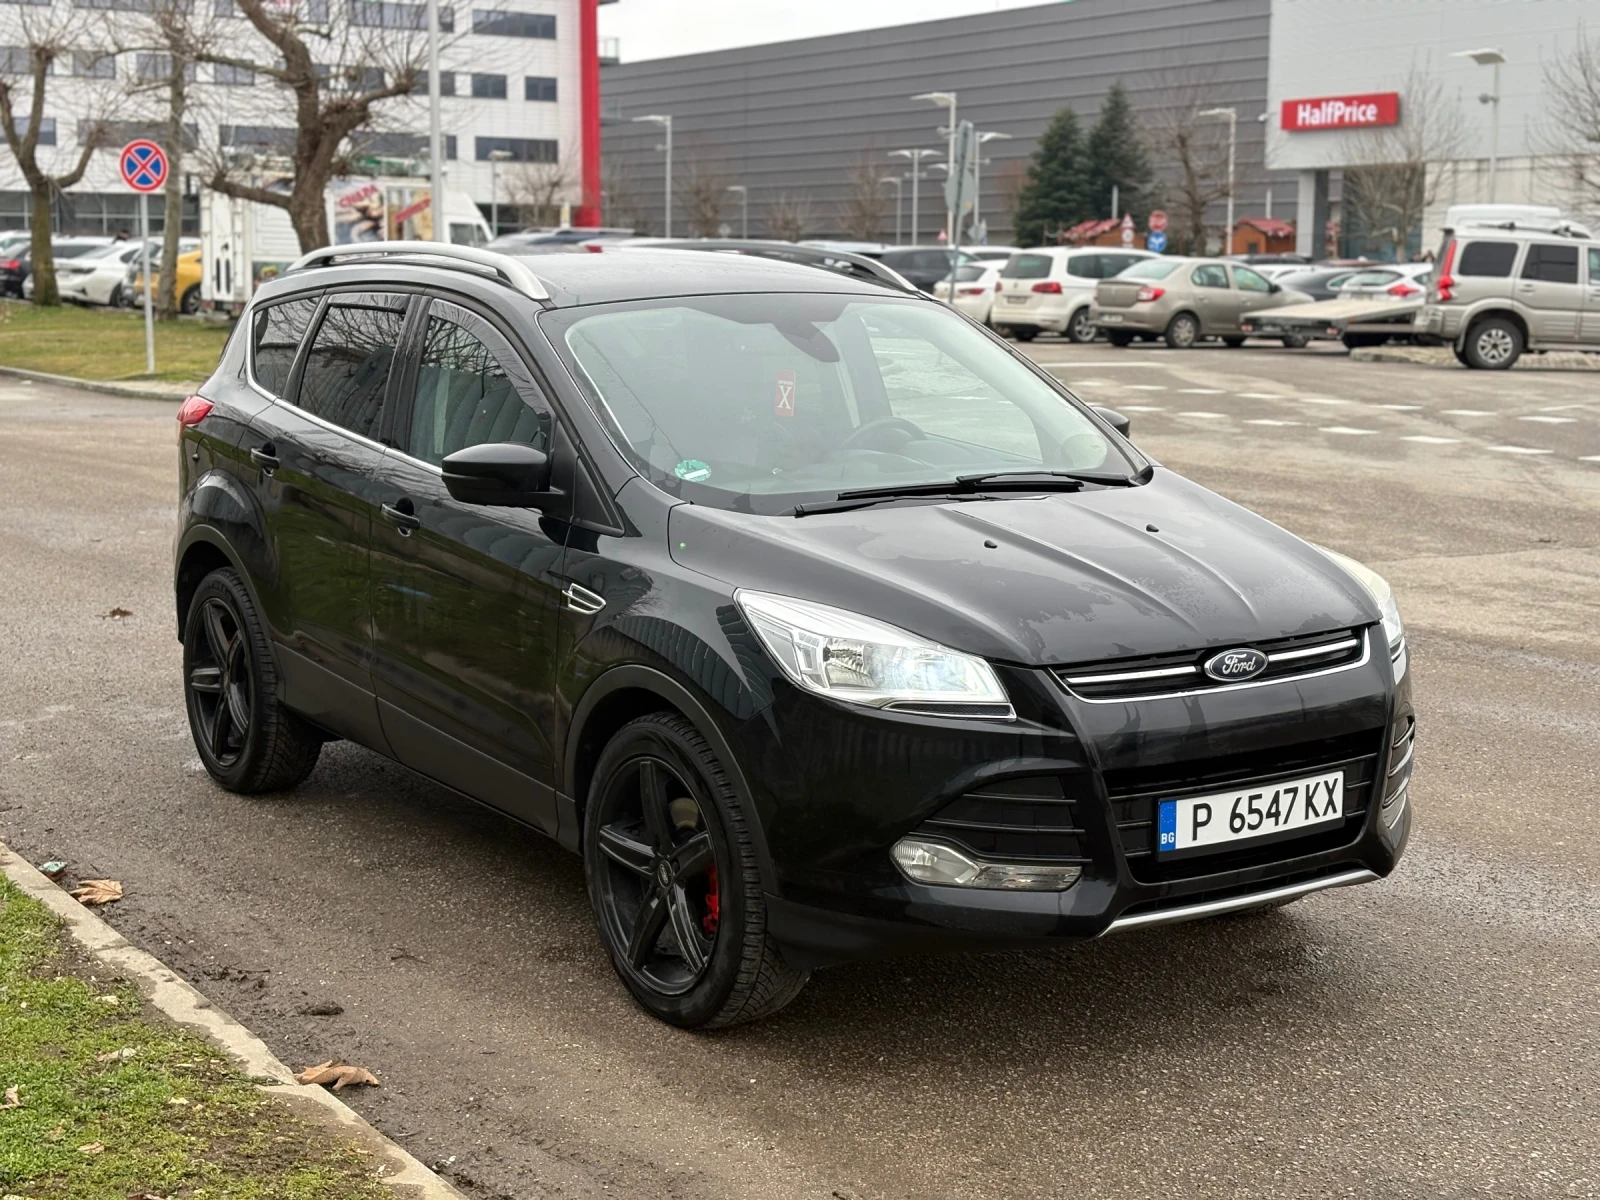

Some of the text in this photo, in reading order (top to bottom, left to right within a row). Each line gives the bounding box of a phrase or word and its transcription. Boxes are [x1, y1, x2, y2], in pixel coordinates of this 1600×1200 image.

[1297, 100, 1378, 126] HalfPrice
[1222, 653, 1256, 674] Ford
[1191, 802, 1212, 841] P
[1229, 786, 1299, 834] 6547
[1160, 832, 1175, 844] BG
